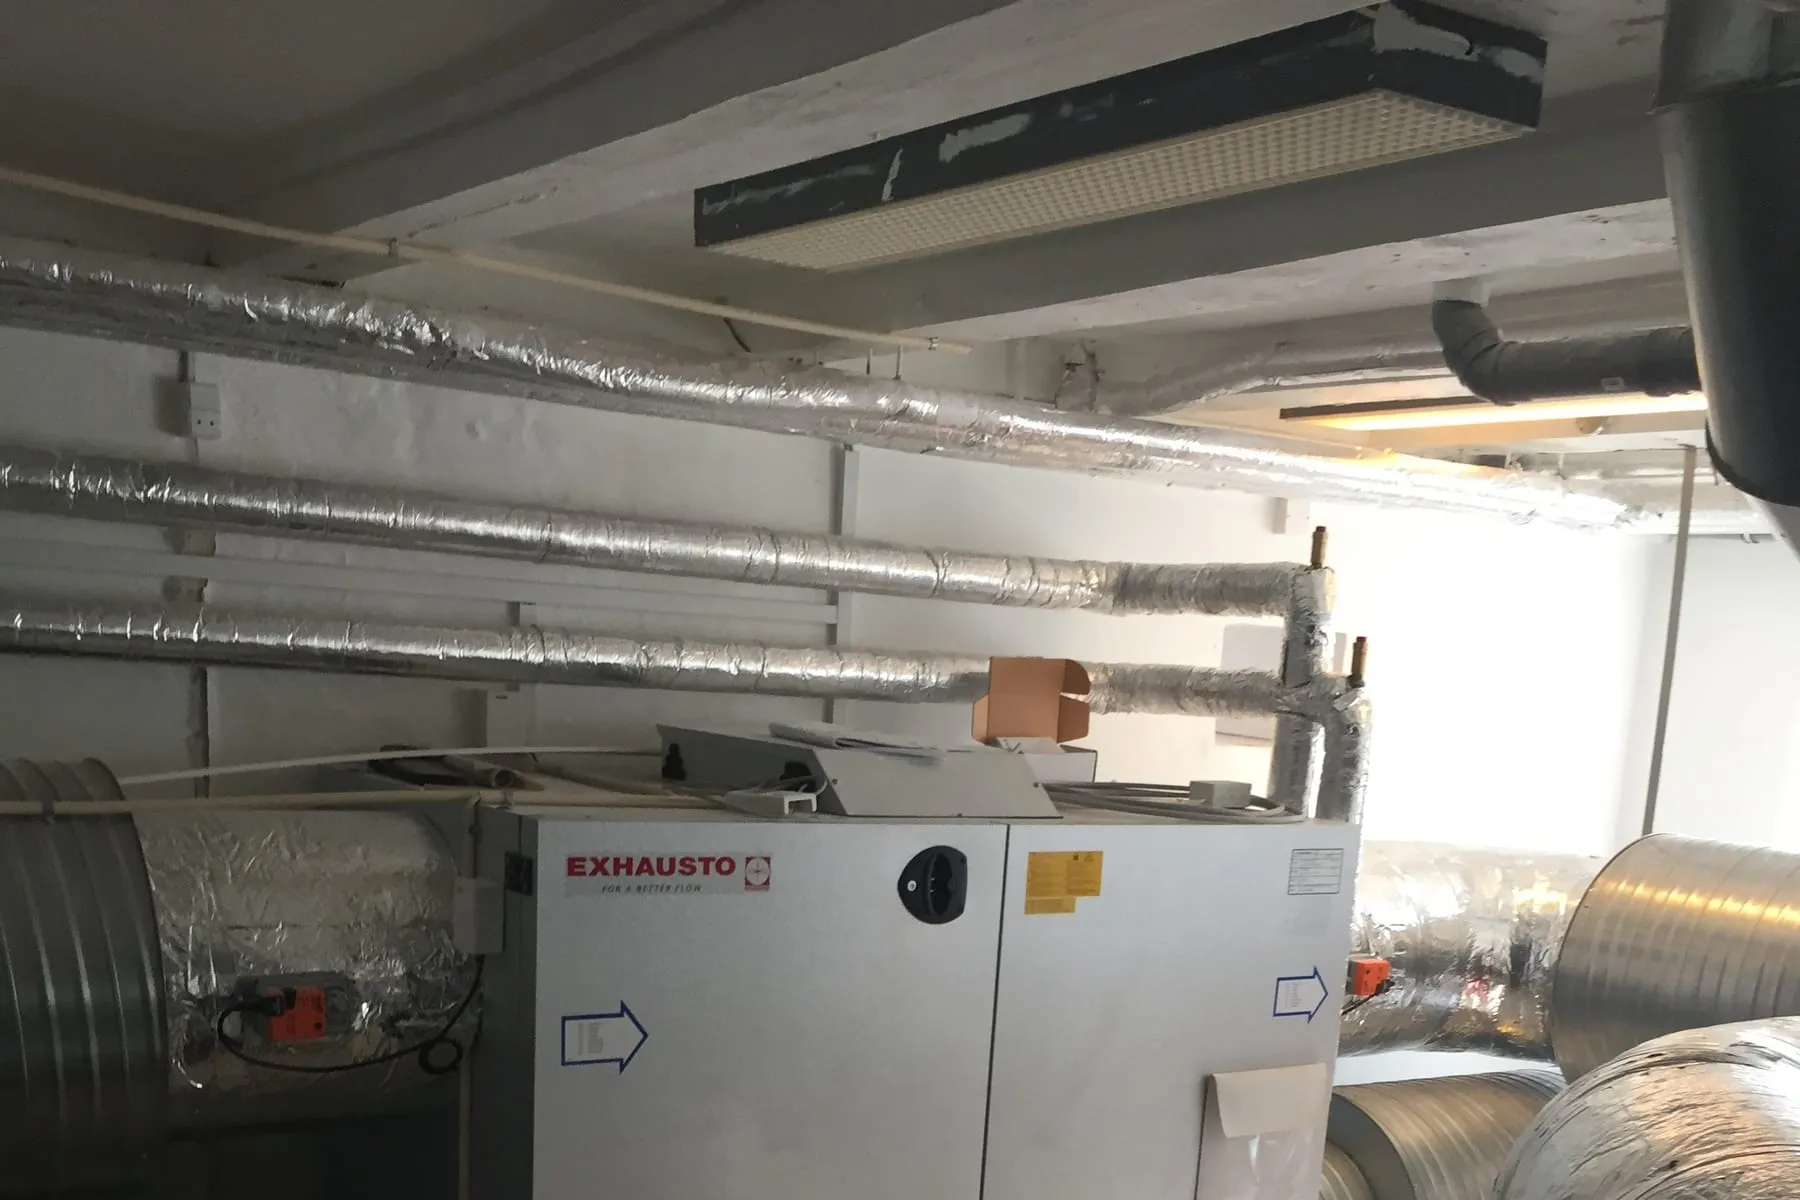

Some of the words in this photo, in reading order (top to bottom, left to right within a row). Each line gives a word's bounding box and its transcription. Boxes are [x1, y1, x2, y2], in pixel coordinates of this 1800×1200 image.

[566, 856, 736, 877] EXHAUSTO
[601, 884, 621, 893] FOR
[624, 884, 632, 893] A
[636, 884, 672, 893] BETTER
[674, 883, 702, 893] FLOW
